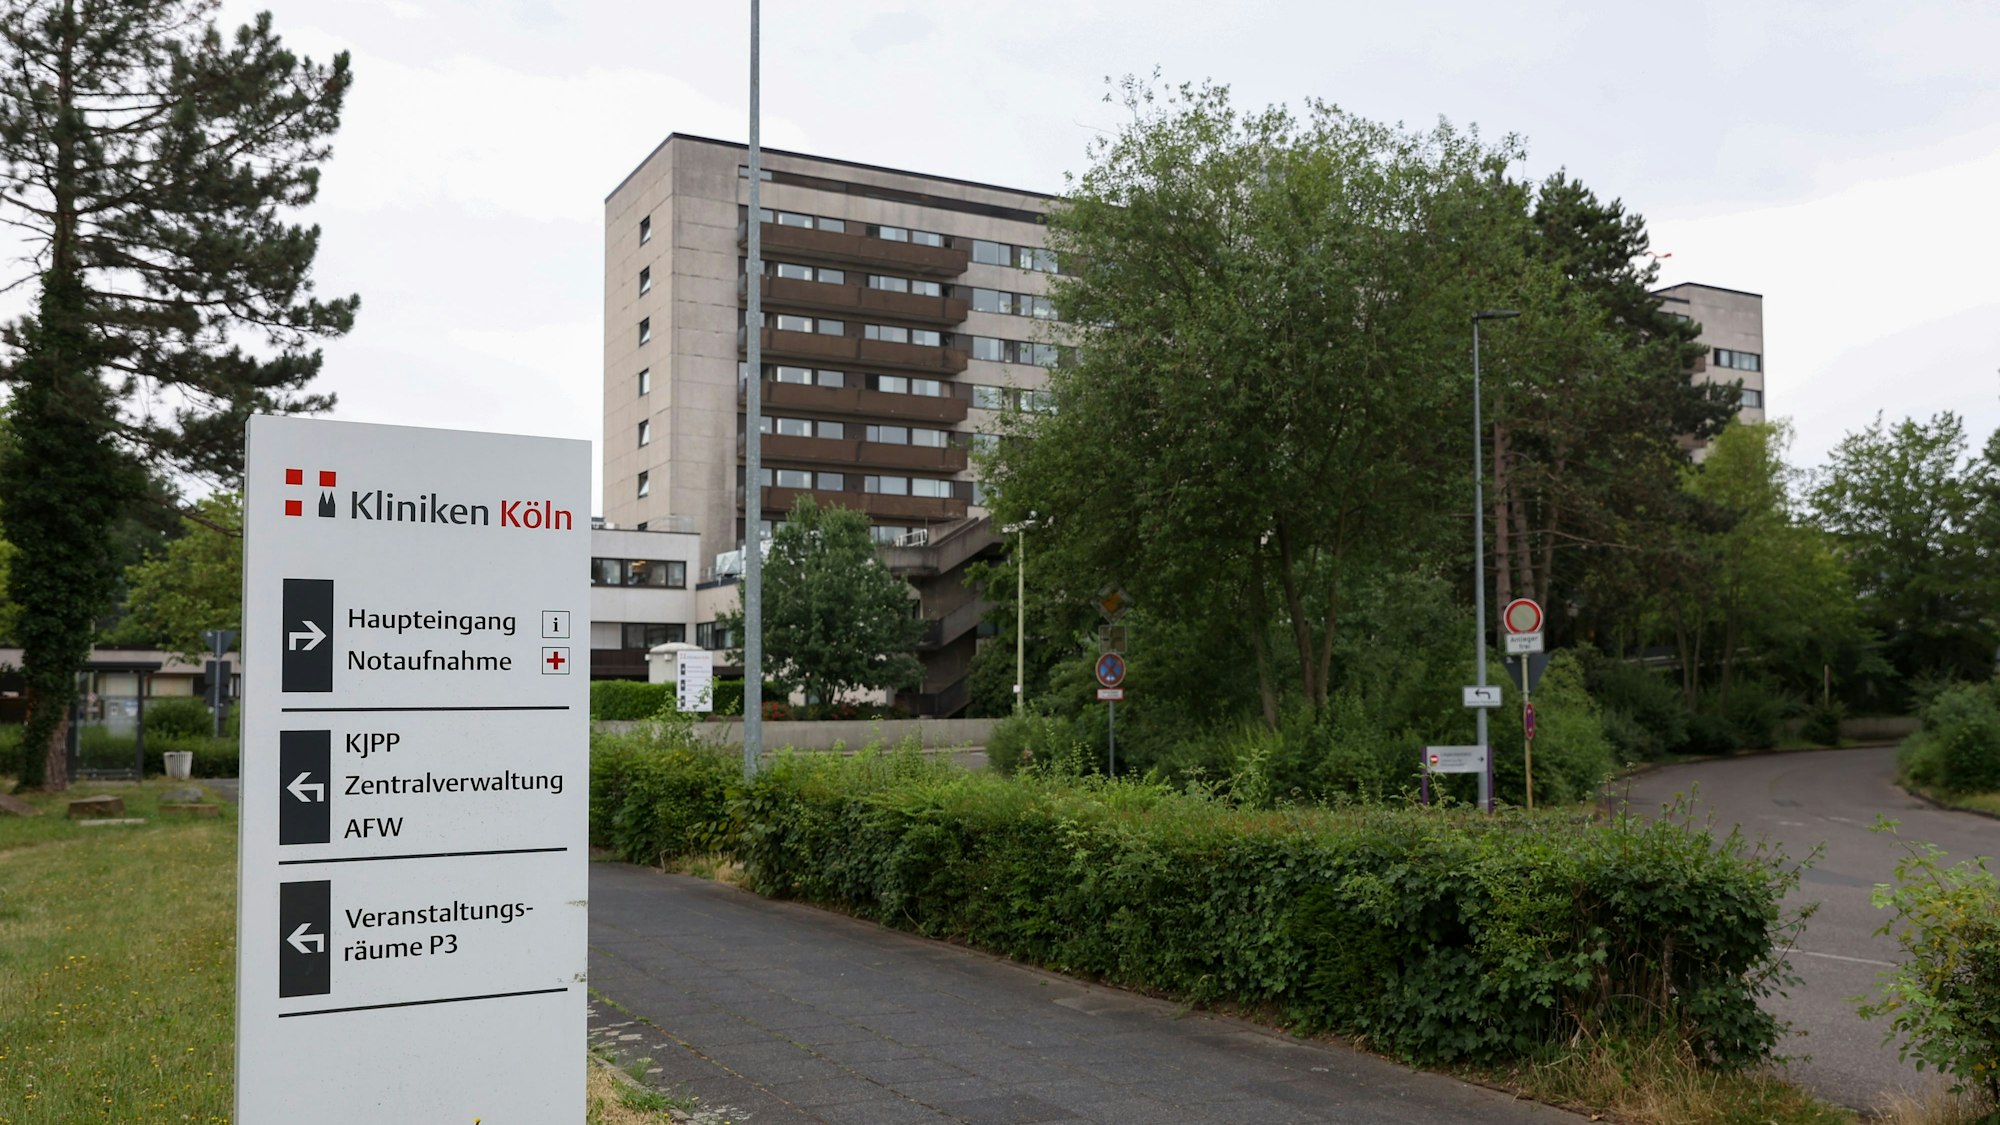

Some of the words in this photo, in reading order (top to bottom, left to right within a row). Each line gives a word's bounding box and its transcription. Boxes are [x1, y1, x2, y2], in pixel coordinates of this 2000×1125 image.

[351, 490, 489, 525] Kliniken
[500, 500, 572, 530] Köln
[348, 609, 516, 636] Haupteingang
[348, 650, 512, 671] Notaufnahme
[346, 733, 401, 758] KJPP
[344, 770, 563, 795] Zentralverwaltung
[344, 817, 404, 839] AFW
[344, 900, 534, 929] Veranstaltungs-
[344, 939, 423, 962] räume
[430, 934, 458, 955] P3
